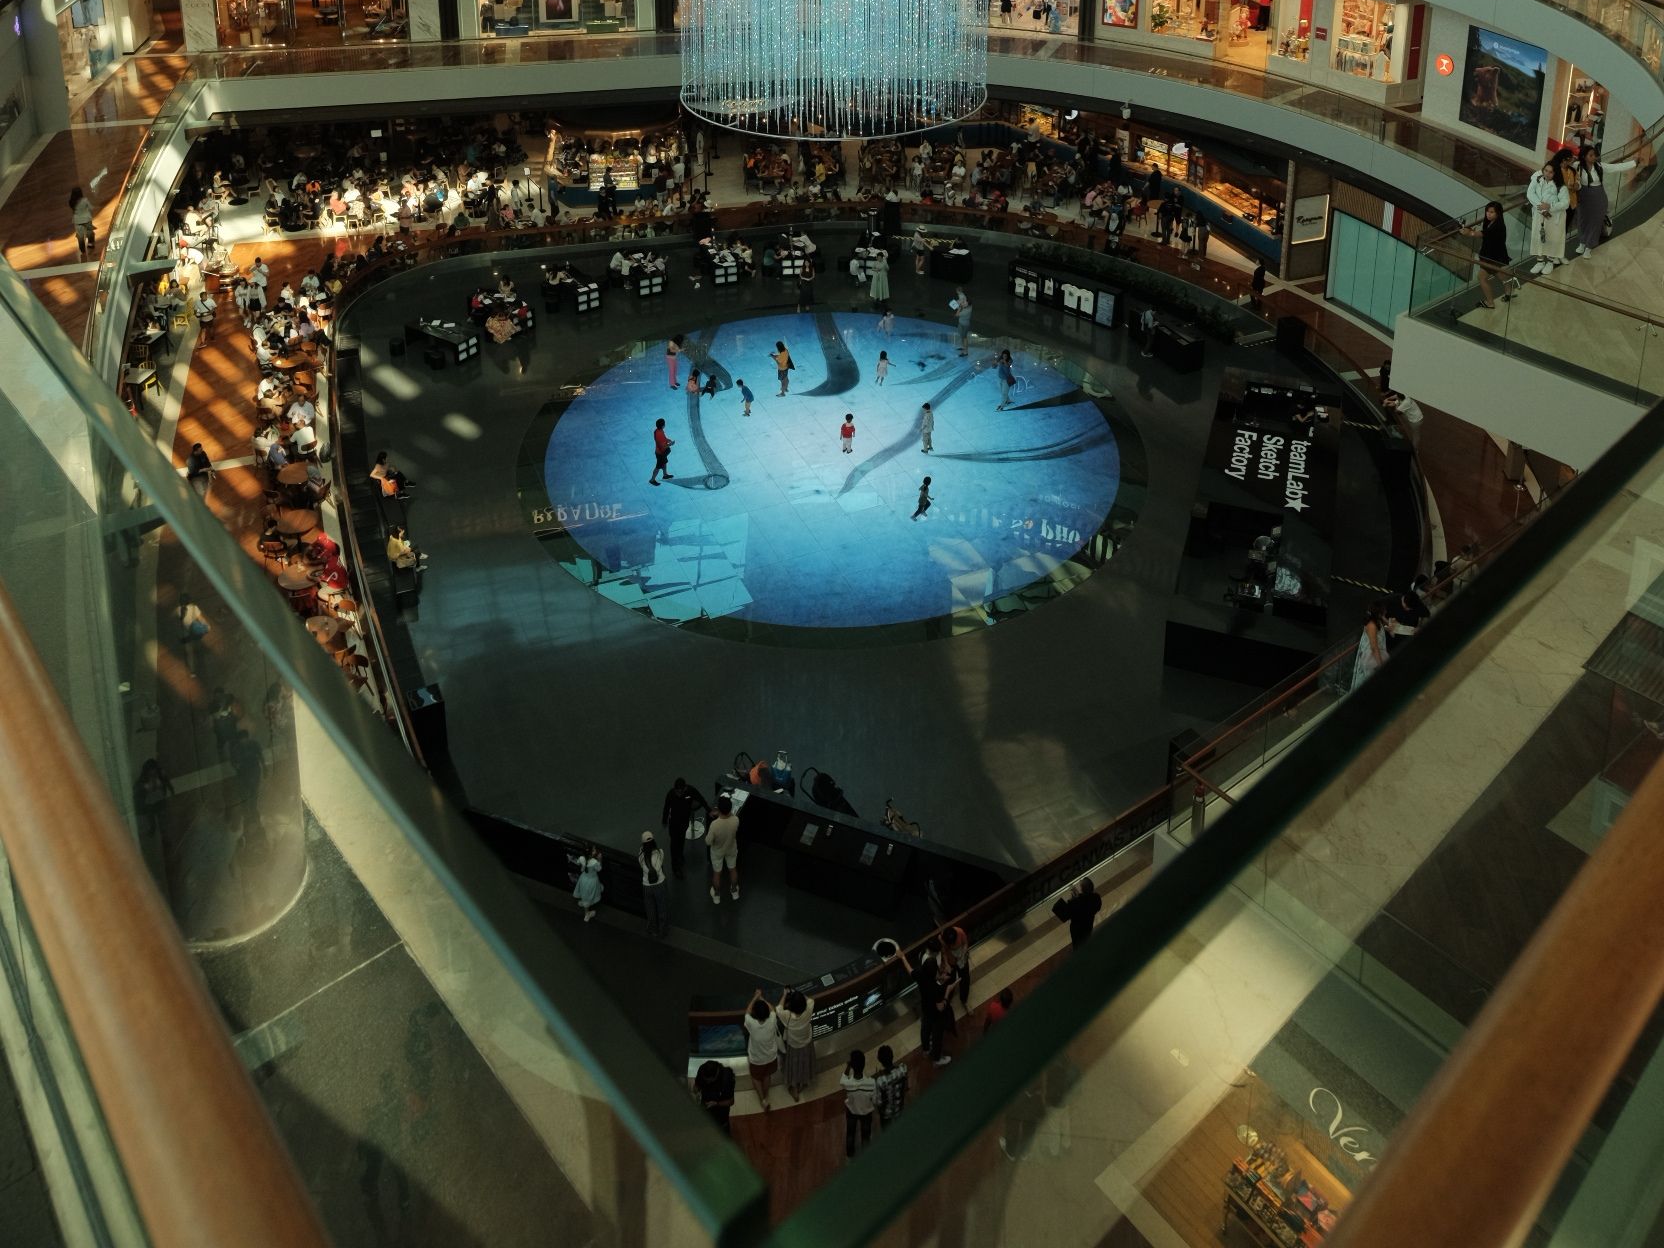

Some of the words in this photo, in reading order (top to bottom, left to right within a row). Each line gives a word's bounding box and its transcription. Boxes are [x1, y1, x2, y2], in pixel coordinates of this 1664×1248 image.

[1224, 429, 1258, 481] Factory
[1257, 434, 1285, 480] Sketch
[1285, 440, 1312, 499] teamLab
